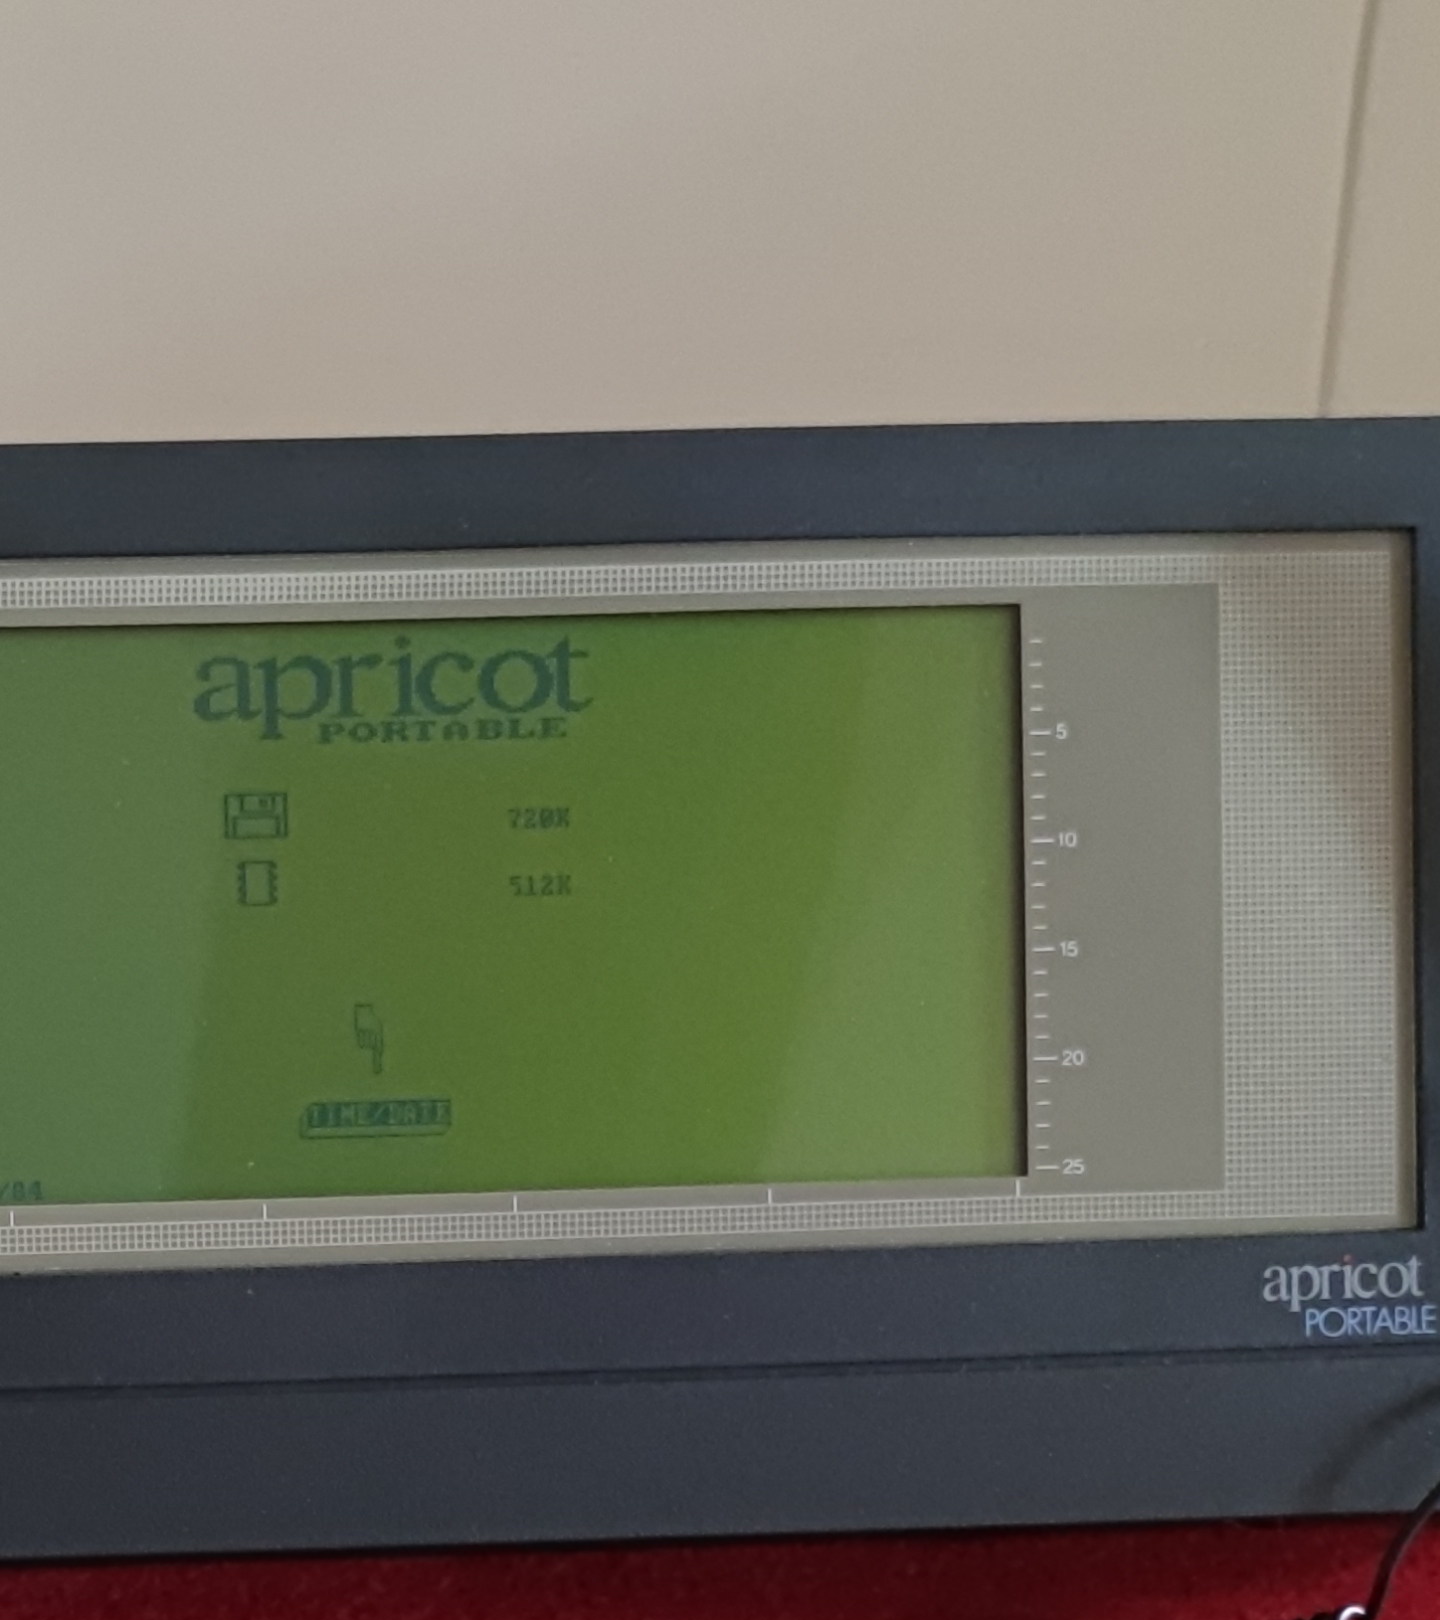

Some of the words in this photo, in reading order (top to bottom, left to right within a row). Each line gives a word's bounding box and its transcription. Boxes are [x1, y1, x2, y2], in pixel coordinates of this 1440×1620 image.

[193, 635, 593, 740] apricot
[318, 717, 567, 744] PORTABLE
[1055, 721, 1068, 740] 5
[508, 807, 570, 830] 720K
[1058, 831, 1078, 848] 10
[509, 874, 571, 897] 512K
[1059, 940, 1079, 958] 15
[1061, 1049, 1086, 1067] 20
[1062, 1158, 1086, 1175] 25
[1262, 1254, 1425, 1312] apricot
[1304, 1303, 1438, 1338] PORTABLE
